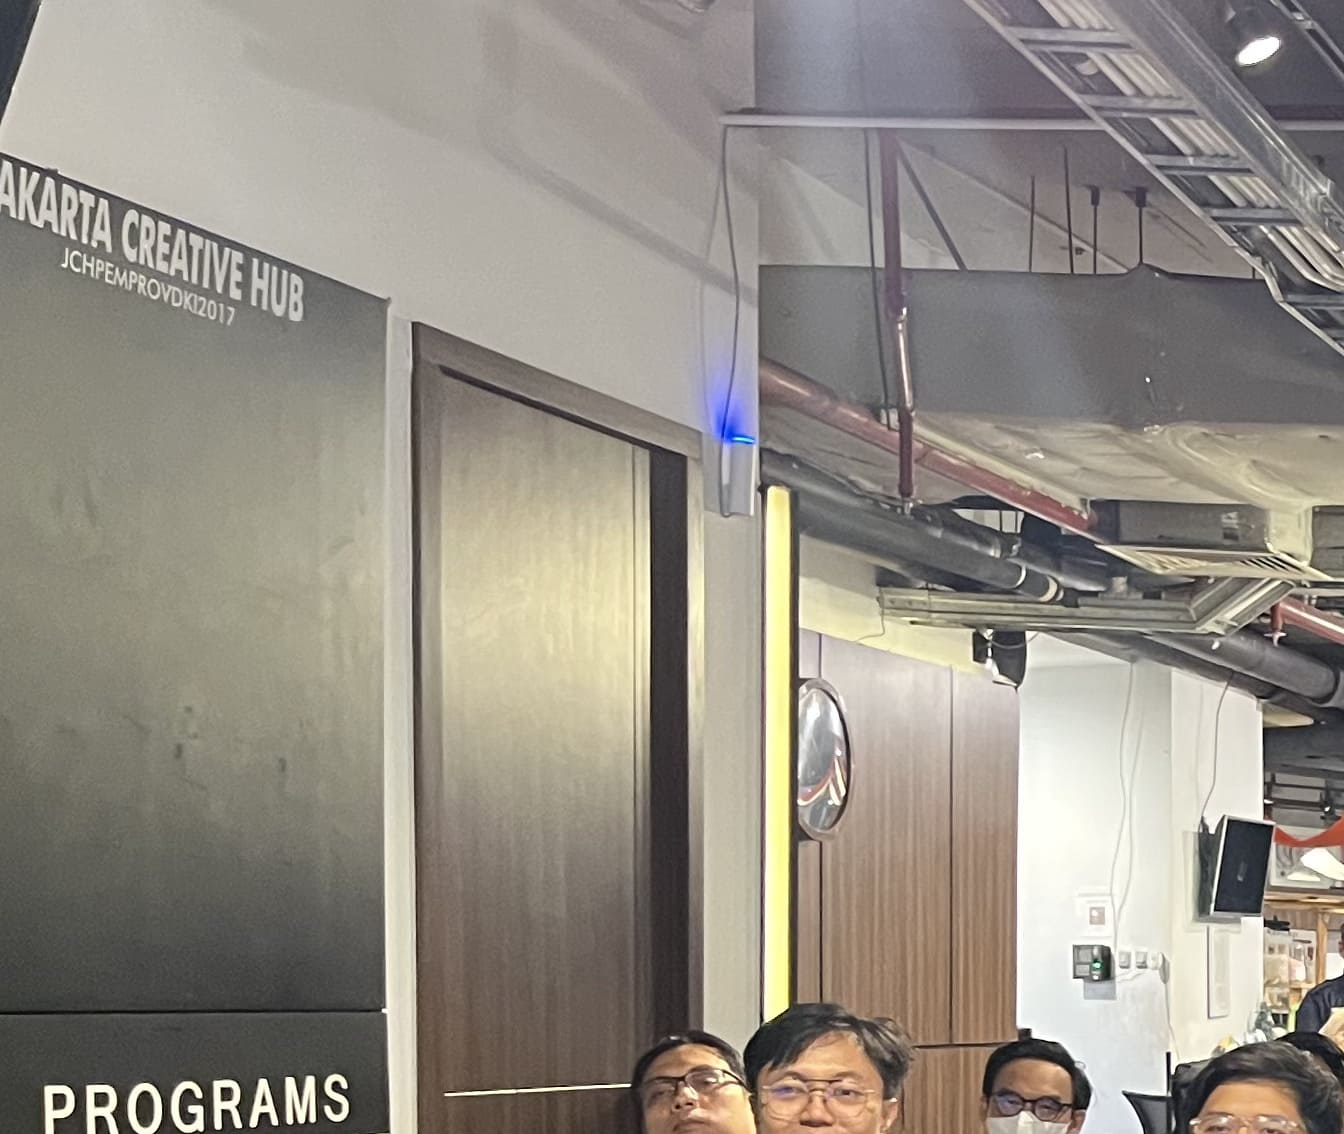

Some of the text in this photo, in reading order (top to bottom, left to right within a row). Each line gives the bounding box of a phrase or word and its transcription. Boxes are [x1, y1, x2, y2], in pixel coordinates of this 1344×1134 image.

[0, 160, 304, 322] AKARTA CREATIVE HUB
[61, 247, 236, 326] JCHPEMPROVDKI2017
